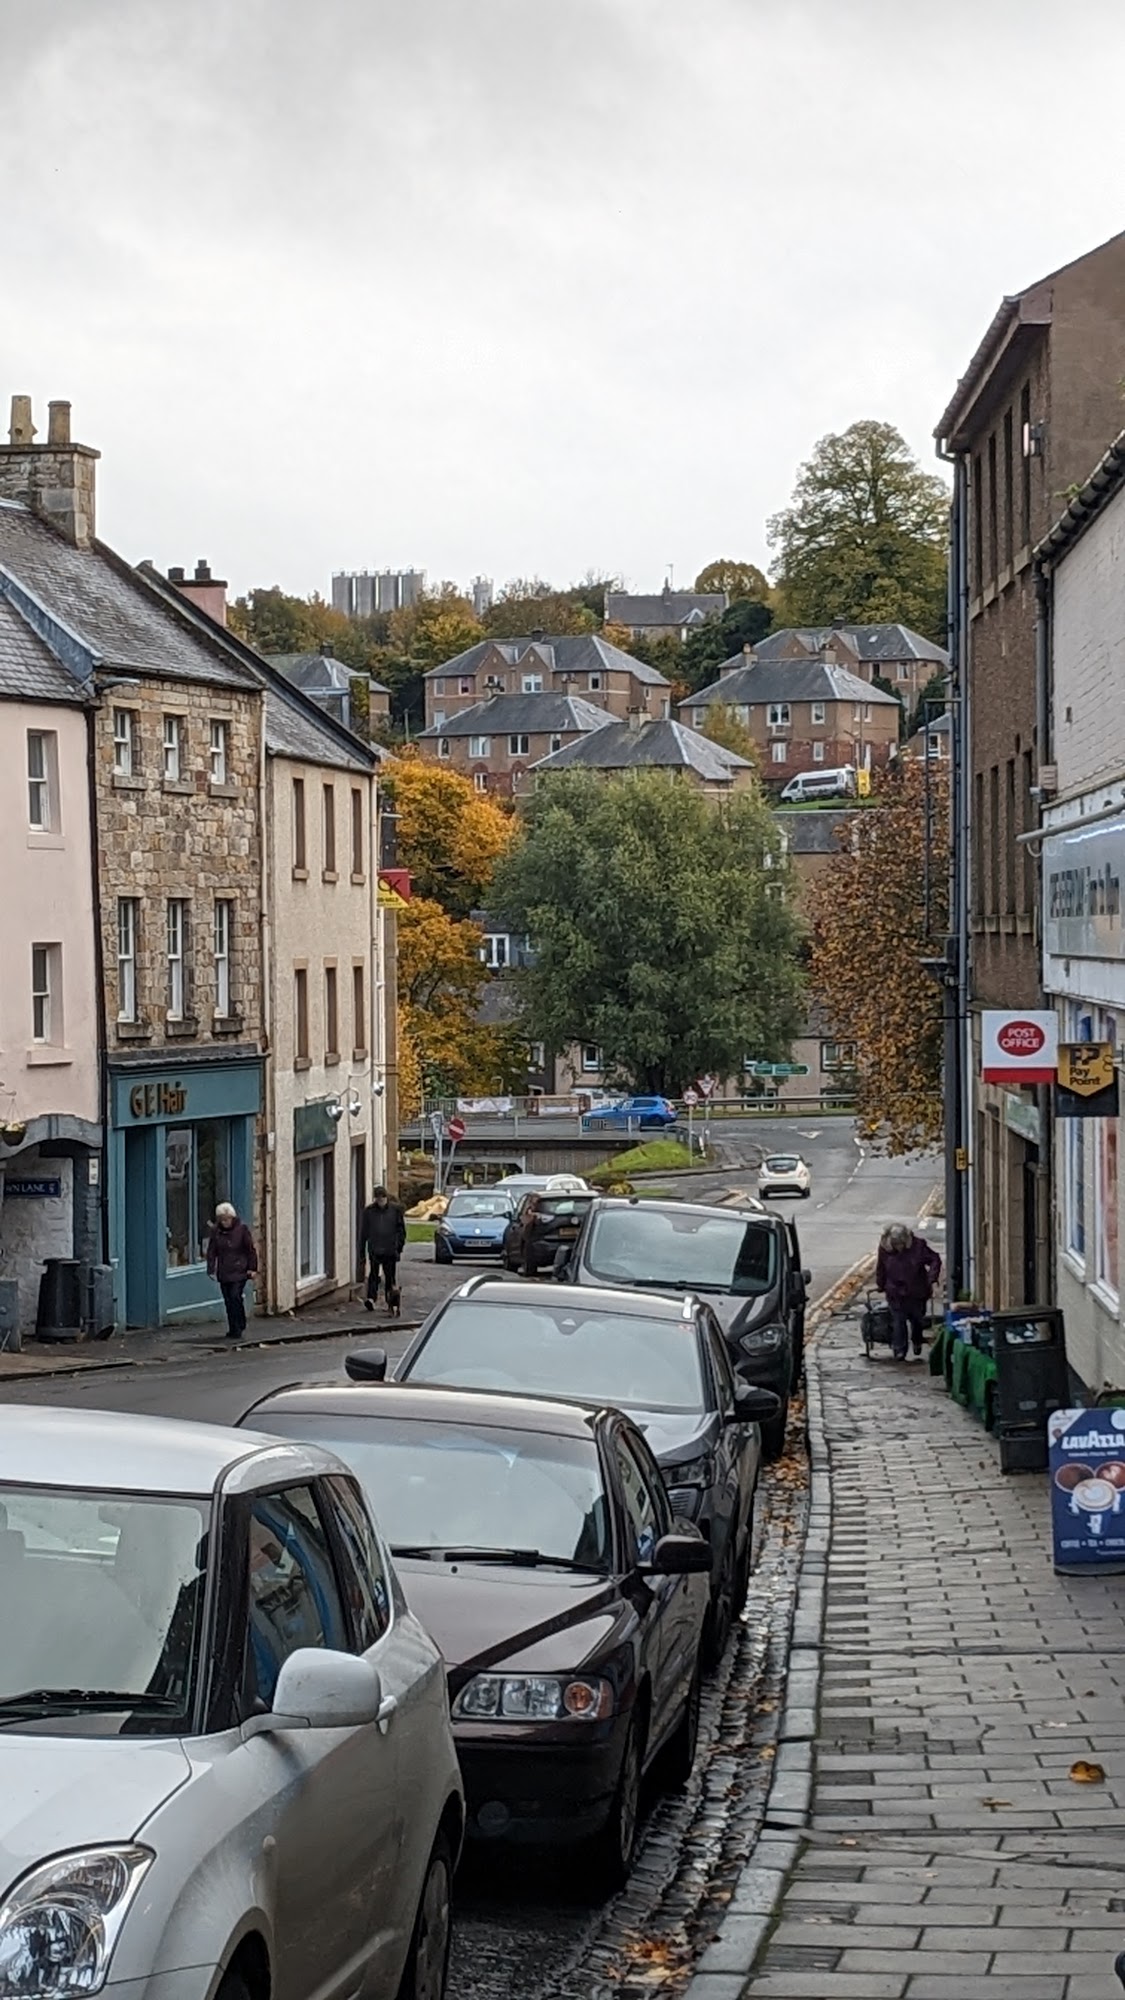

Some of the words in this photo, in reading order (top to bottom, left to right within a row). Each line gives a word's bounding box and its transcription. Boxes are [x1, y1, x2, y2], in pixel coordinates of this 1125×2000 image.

[1008, 1028, 1035, 1038] POST
[1001, 1038, 1040, 1048] OFFICE
[1070, 1067, 1090, 1077] Pay
[1069, 1077, 1100, 1085] Point
[21, 1183, 45, 1193] LANE
[1061, 1431, 1125, 1449] LAVAZZA
